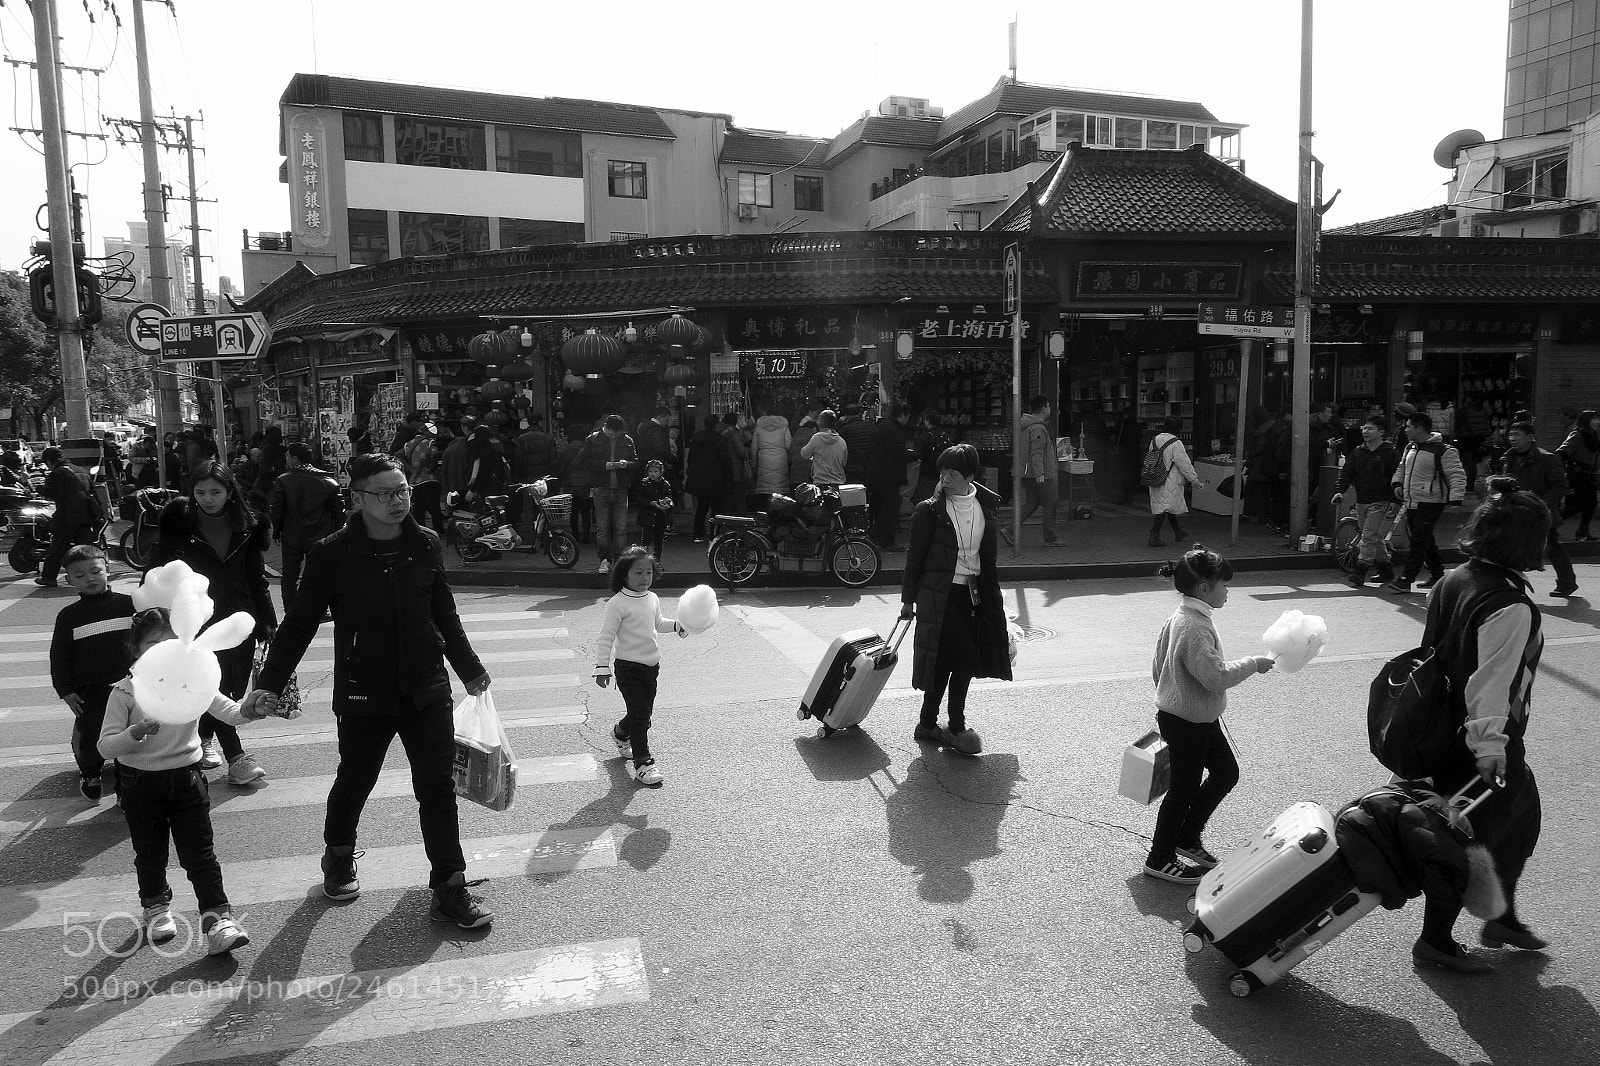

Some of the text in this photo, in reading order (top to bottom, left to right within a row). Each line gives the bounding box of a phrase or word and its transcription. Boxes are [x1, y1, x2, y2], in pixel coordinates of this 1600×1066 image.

[1205, 306, 1214, 315] 东
[1224, 308, 1274, 324] 福佑路
[741, 317, 841, 339] 奥博礼品
[880, 331, 894, 340] 368
[164, 348, 178, 356] LINE
